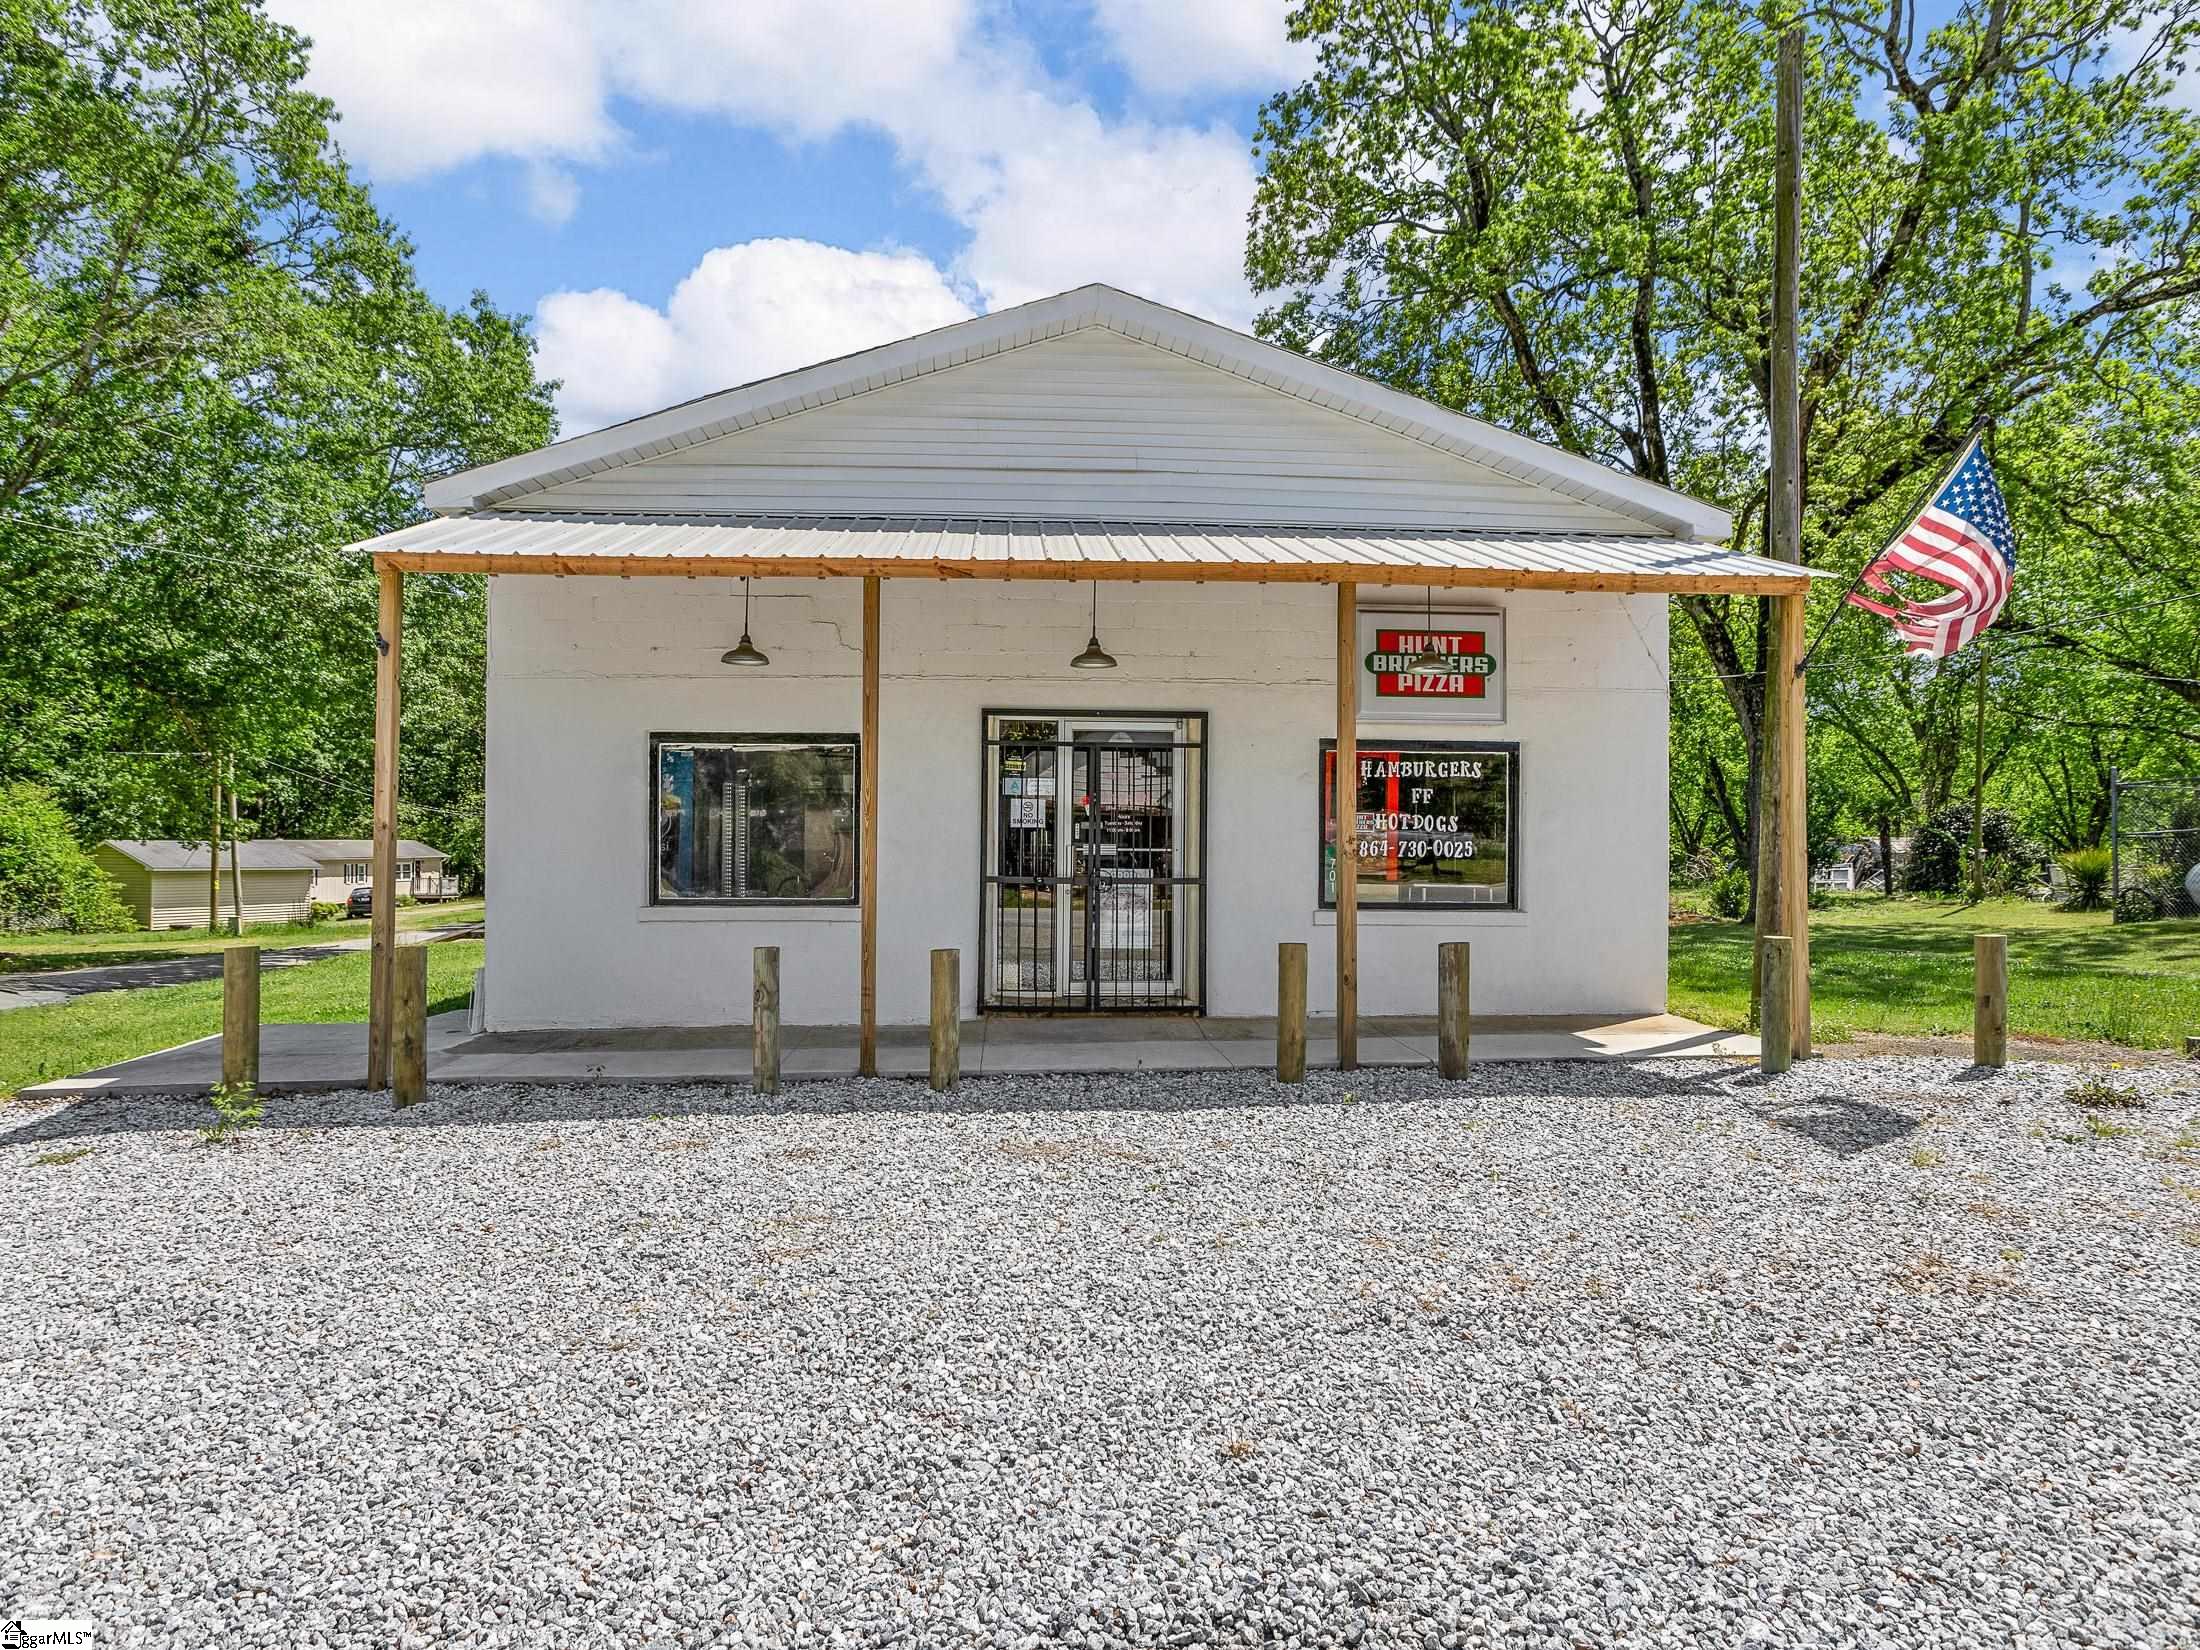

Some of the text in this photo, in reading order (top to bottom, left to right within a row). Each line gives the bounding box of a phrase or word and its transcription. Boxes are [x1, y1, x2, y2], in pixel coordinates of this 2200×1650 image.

[1398, 635, 1463, 654] HUNT
[1398, 673, 1464, 692] PIZZA
[1360, 760, 1482, 778] HAMBURGERS
[1411, 788, 1434, 803] FF
[1375, 813, 1459, 832] HOTDOGS
[1360, 839, 1473, 858] 864-730-0025
